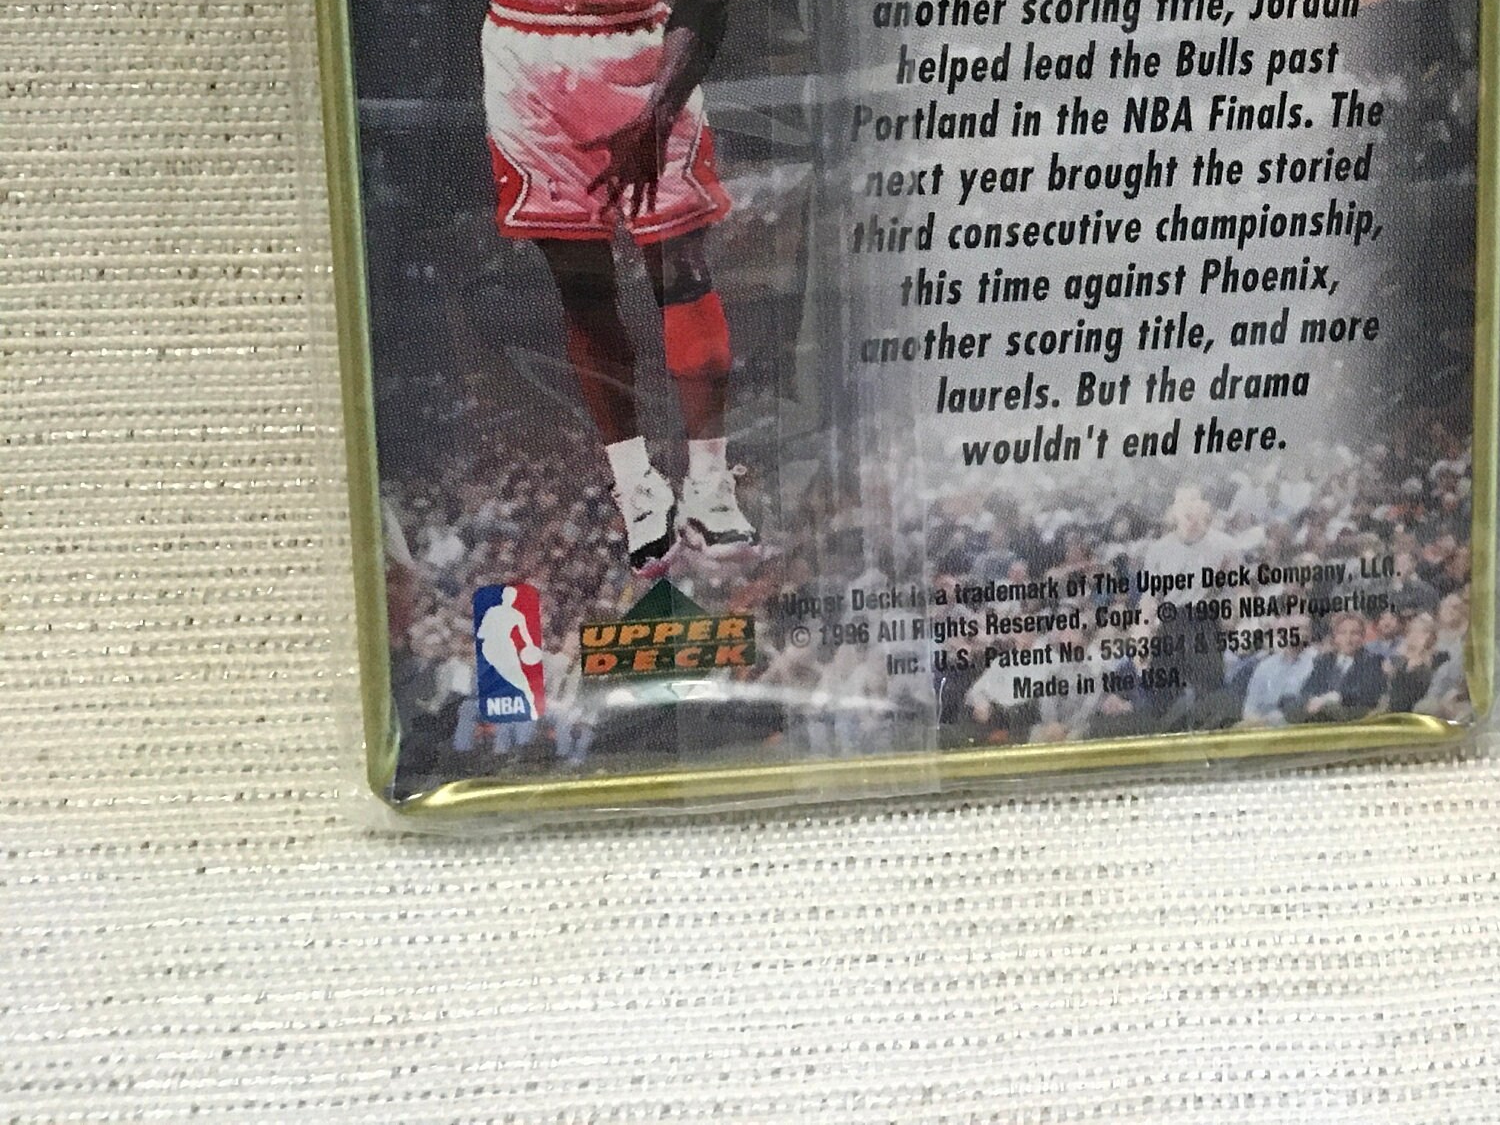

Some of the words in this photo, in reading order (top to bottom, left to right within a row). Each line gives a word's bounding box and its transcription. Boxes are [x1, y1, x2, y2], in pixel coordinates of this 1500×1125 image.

[897, 43, 1010, 94] helped
[1024, 42, 1096, 81] lead
[1110, 40, 1161, 78] the
[1176, 37, 1253, 76] Bulls
[1267, 42, 1339, 85] past
[851, 99, 1000, 141] Portland
[1013, 101, 1041, 137] in
[1056, 97, 1109, 136] the
[1123, 95, 1192, 132] NBA
[1208, 92, 1312, 132] Finals.
[1331, 89, 1384, 129] The
[864, 162, 944, 199] next
[960, 161, 1034, 205] year
[1048, 150, 1178, 200] brought
[1192, 147, 1242, 186] the
[1257, 144, 1374, 184] storied
[853, 213, 935, 254] third
[948, 211, 1142, 251] consecutive
[1156, 198, 1383, 250] championship,
[900, 268, 962, 307] this
[978, 268, 1050, 303] time
[1064, 262, 1187, 310] against
[1199, 256, 1340, 297] Phoenix,
[860, 321, 992, 363] another
[1005, 318, 1123, 362] scoring
[1137, 314, 1215, 355] title,
[1230, 307, 1290, 346] and
[1300, 310, 1380, 343] more
[937, 376, 1061, 415] laurels.
[1076, 371, 1131, 408] But
[1145, 368, 1196, 404] the
[1209, 364, 1310, 399] drama
[962, 424, 1108, 466] wouldn't
[1123, 419, 1178, 458] end
[1193, 416, 1286, 454] there.
[852, 586, 903, 611] Deck
[935, 588, 948, 605] a
[955, 577, 1058, 605] trademark
[1066, 575, 1086, 597] of
[1094, 573, 1129, 594] The
[1137, 569, 1195, 596] Upper
[1202, 565, 1250, 588] Deck
[583, 618, 747, 648] UPPER
[819, 621, 870, 646] 1996
[878, 619, 905, 643] All
[912, 616, 979, 644] Rights
[1095, 606, 1149, 632] Copr.
[1186, 599, 1232, 623] 1996
[1240, 595, 1279, 618] NBA
[887, 653, 926, 676] Inc.
[934, 647, 975, 671] U.S.
[985, 643, 1053, 669] Patent
[1060, 641, 1092, 663] No.
[1013, 675, 1069, 698] Made
[1077, 673, 1095, 694] in
[1103, 671, 1134, 693] the
[1141, 668, 1187, 691] USA.
[486, 696, 526, 717] NBA
